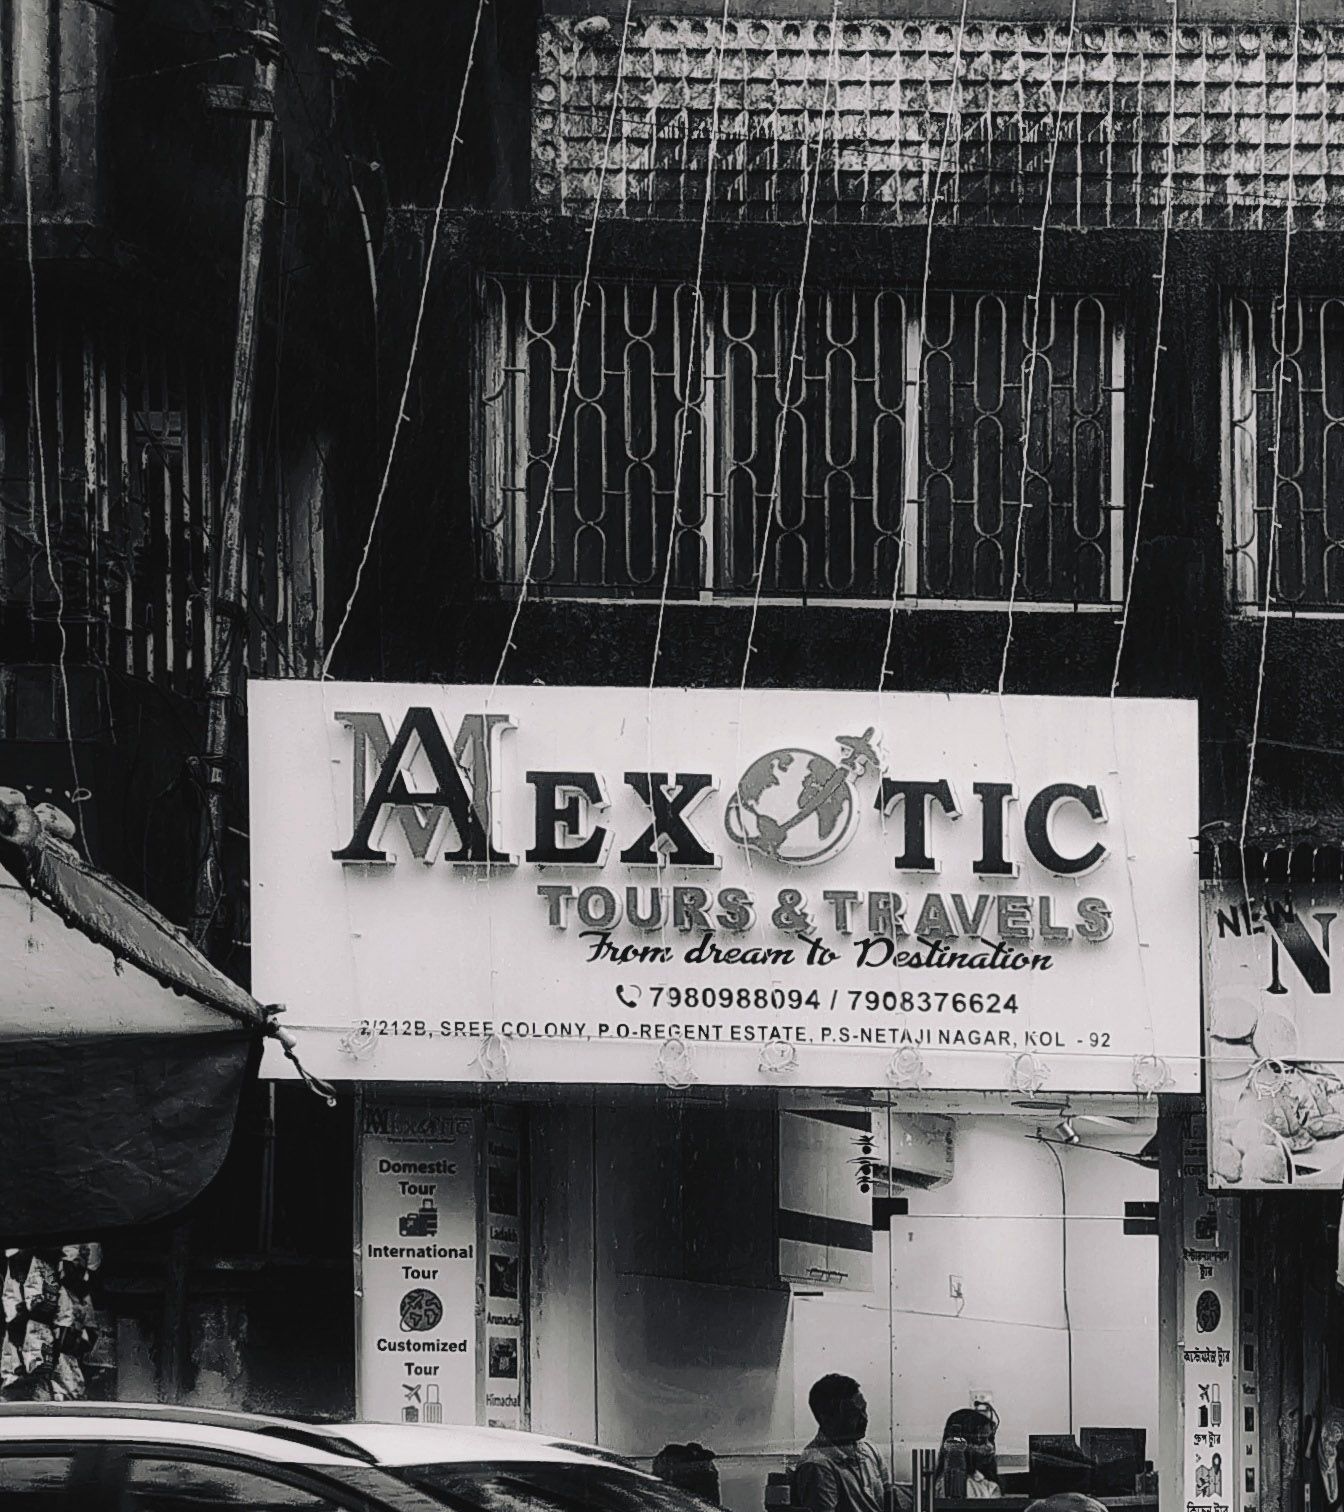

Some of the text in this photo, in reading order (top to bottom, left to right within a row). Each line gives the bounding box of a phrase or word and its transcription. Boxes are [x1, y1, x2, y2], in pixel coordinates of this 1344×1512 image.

[537, 885, 1114, 942] TOURS & TRAVELS
[578, 930, 675, 967] From
[683, 932, 797, 966] dream
[853, 937, 1055, 972] Destination
[649, 986, 821, 1010] 7980988094
[847, 989, 1020, 1015] 7908376624
[440, 1020, 494, 1037] SREE
[502, 1021, 592, 1041] COLONY,
[730, 1025, 813, 1044] ESTATE,
[938, 1029, 1018, 1048] NAGAR,
[1024, 1030, 1066, 1047] KOL
[1089, 1032, 1112, 1048] 92
[378, 1158, 457, 1175] Domestic
[398, 1181, 437, 1196] Tour
[367, 1244, 474, 1259] International
[401, 1266, 439, 1280] Tour
[377, 1338, 468, 1353] Customized
[404, 1362, 440, 1376] Tour
